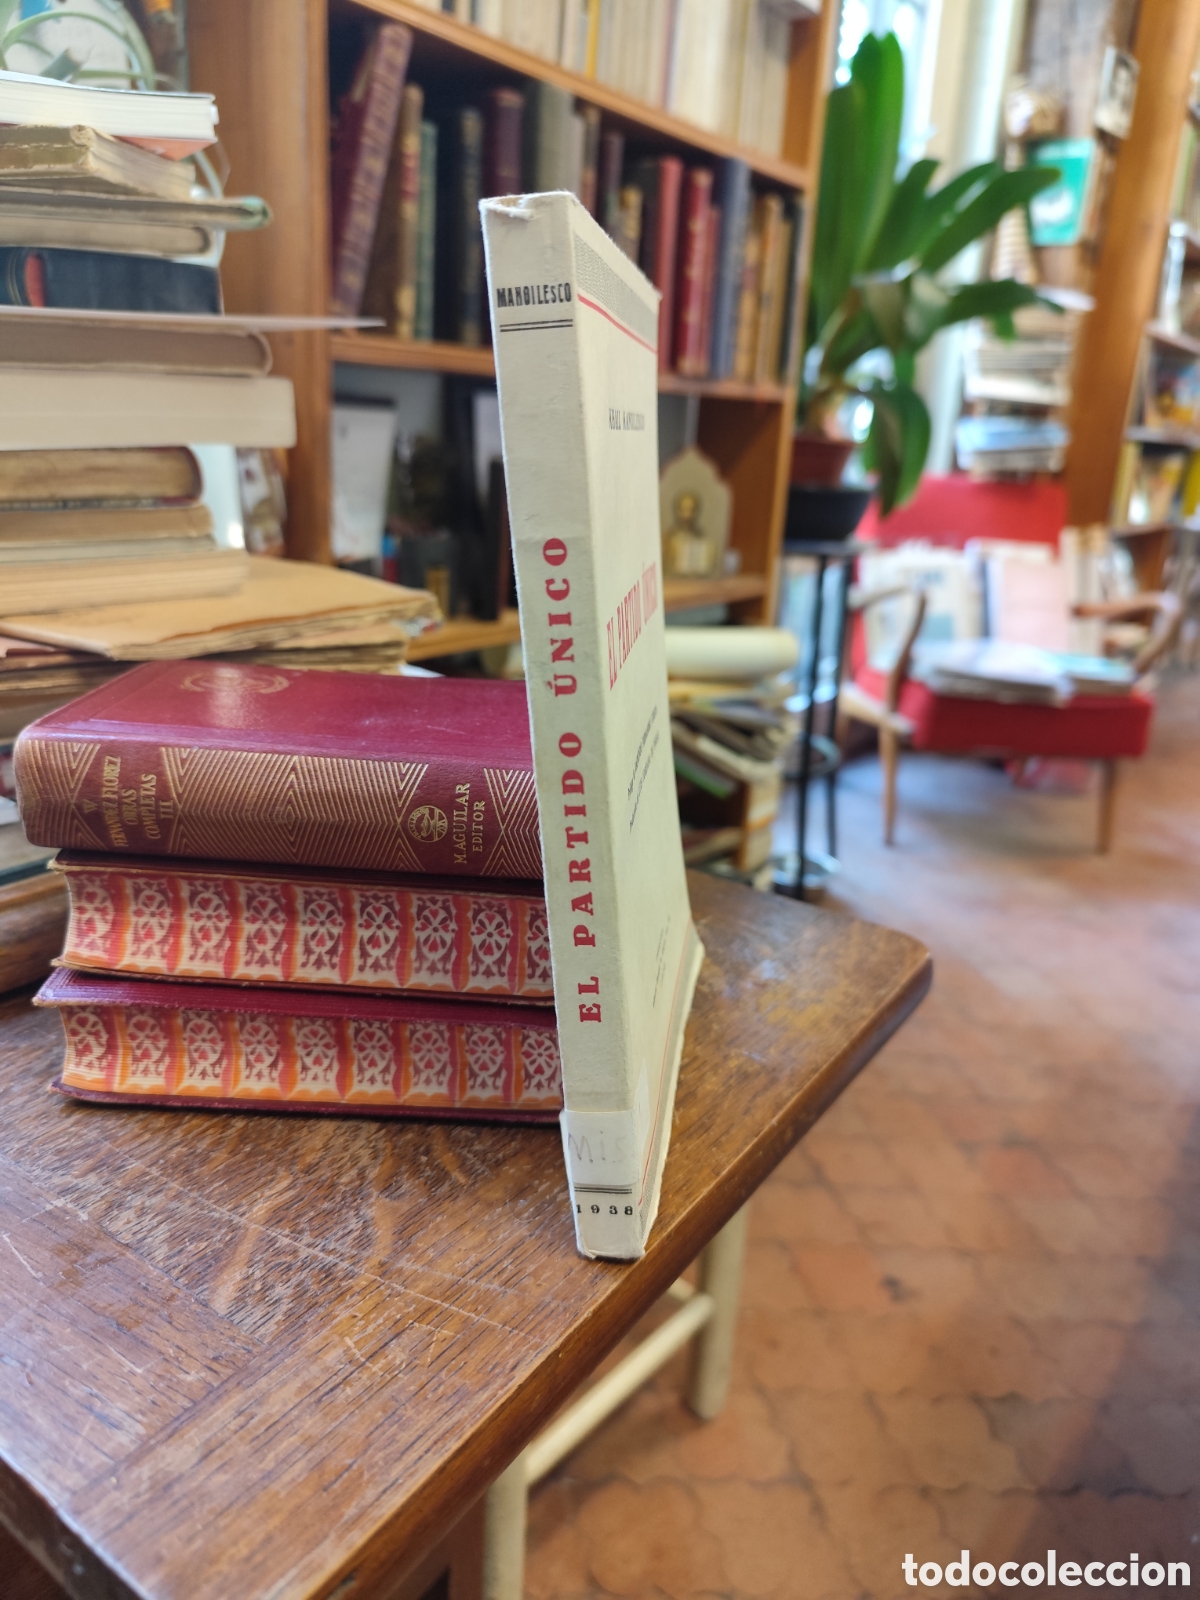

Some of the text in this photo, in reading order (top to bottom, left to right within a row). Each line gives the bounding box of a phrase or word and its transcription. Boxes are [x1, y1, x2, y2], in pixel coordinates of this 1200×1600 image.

[543, 537, 602, 1023] EL PARTIDO ÚNICO
[122, 788, 138, 825] OBRAS
[140, 773, 161, 839] COMPLETAS
[160, 800, 173, 819] III
[473, 800, 485, 852] EDITOR
[576, 1204, 634, 1215] 1938
